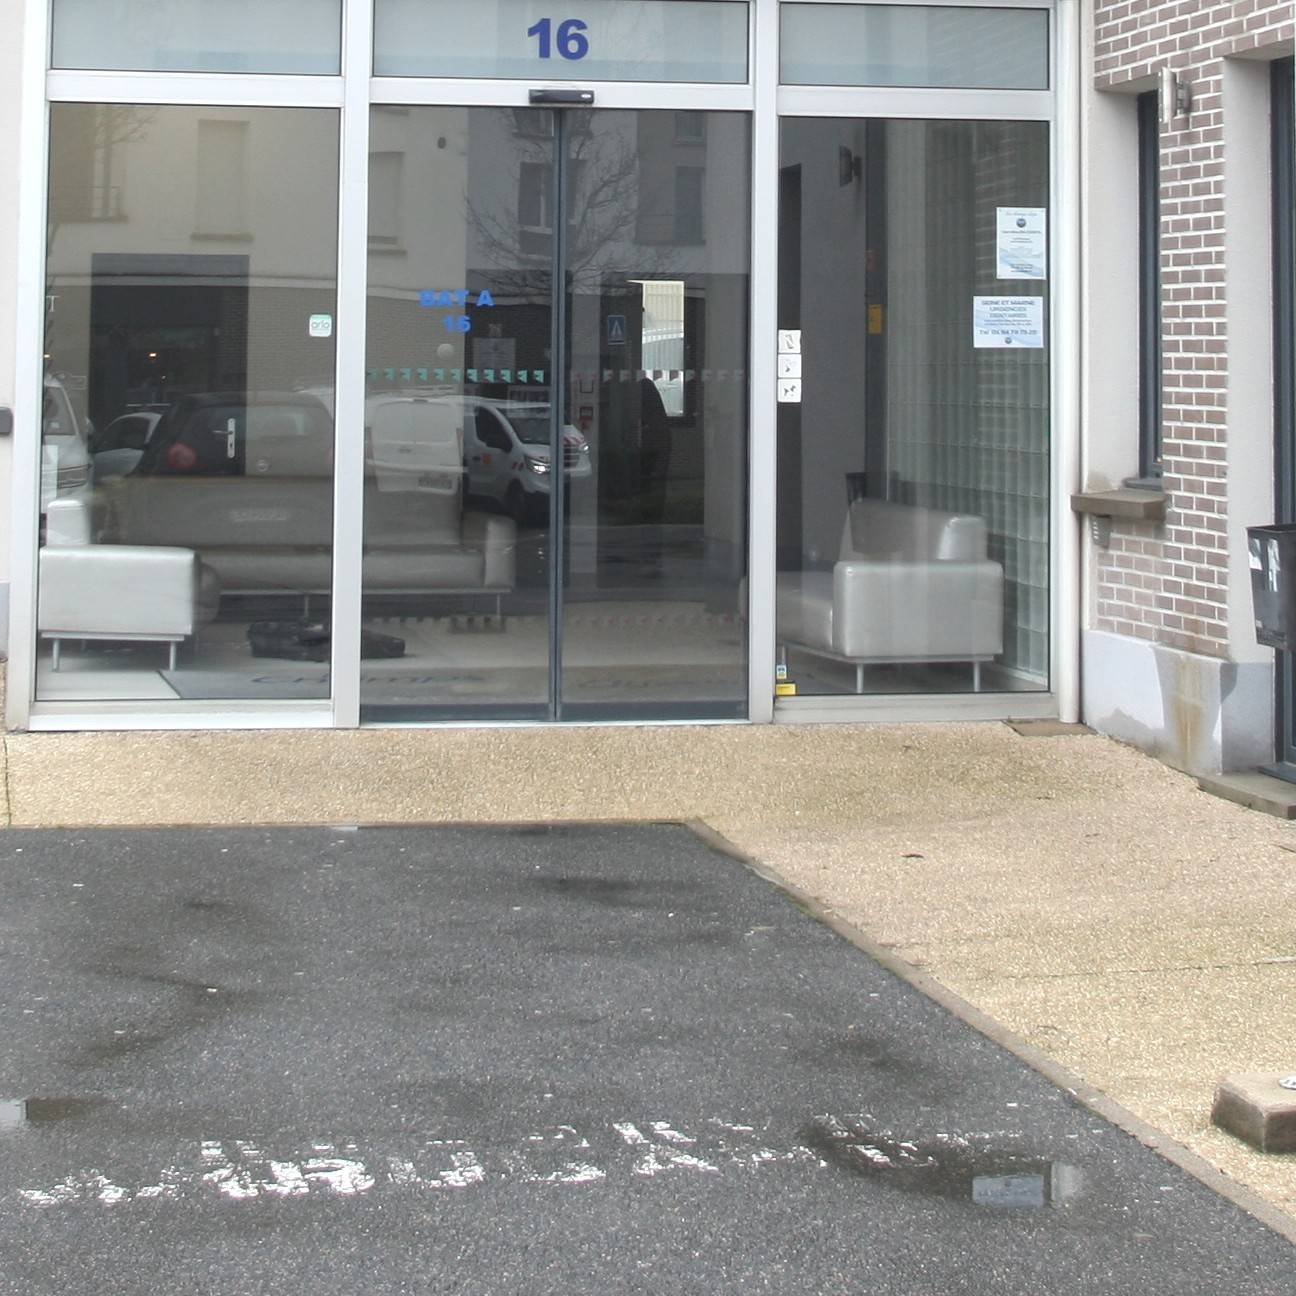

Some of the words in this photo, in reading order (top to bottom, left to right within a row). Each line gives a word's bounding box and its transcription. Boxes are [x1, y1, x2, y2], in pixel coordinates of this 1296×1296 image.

[527, 18, 590, 61] 16
[419, 288, 469, 307] BAT
[476, 288, 495, 306] A
